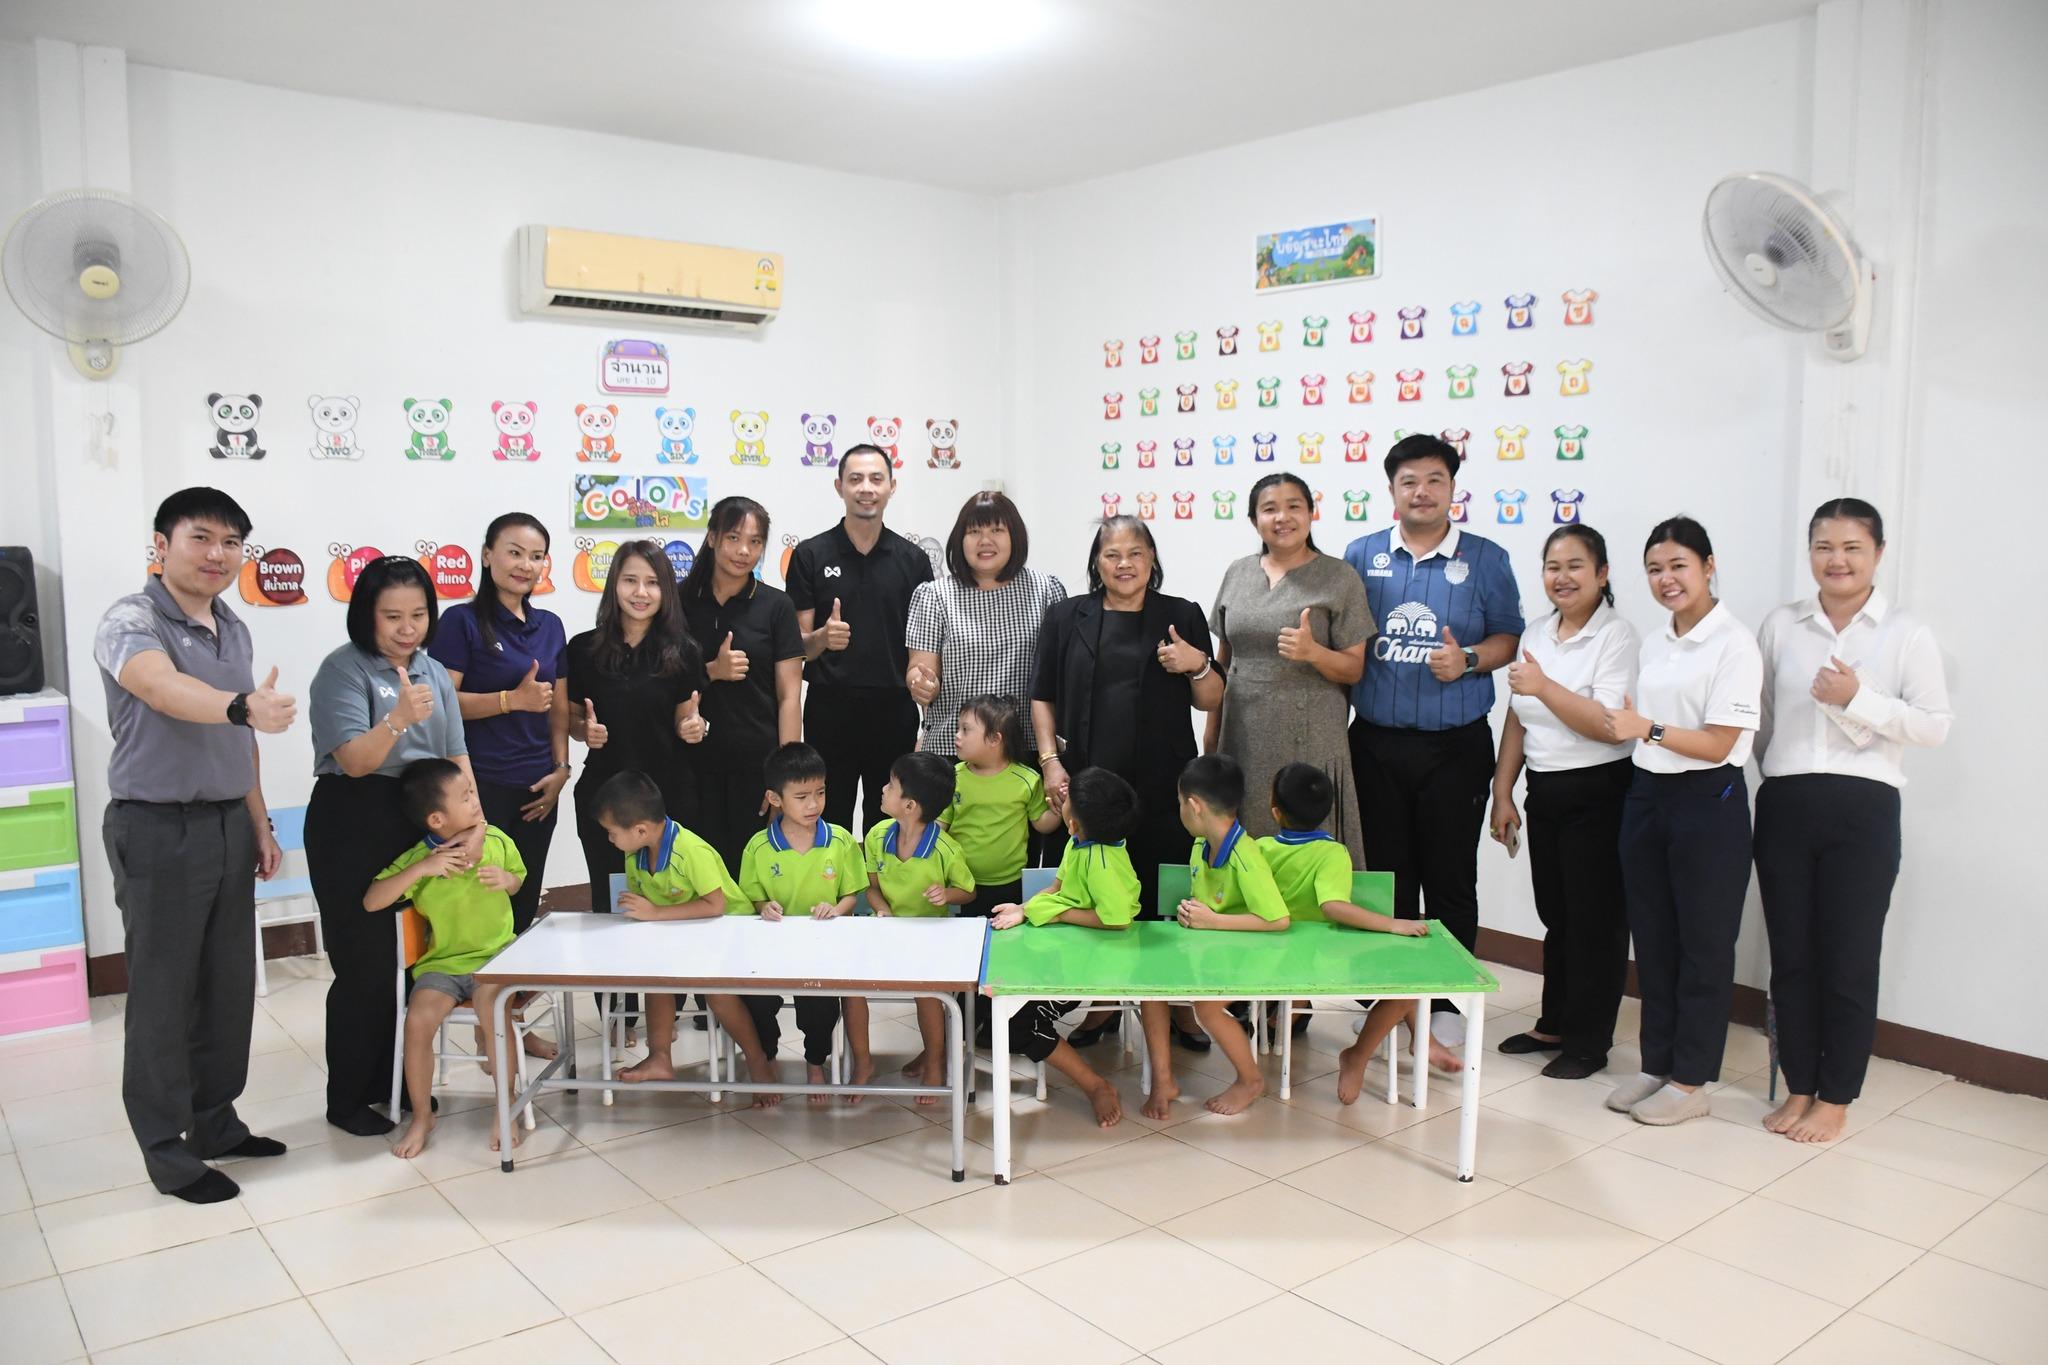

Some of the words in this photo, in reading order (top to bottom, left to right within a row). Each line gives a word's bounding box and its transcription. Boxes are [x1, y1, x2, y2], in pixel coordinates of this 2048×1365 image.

[611, 357, 662, 374] จำนวน
[647, 377, 657, 386] 10
[234, 434, 241, 446] 1
[326, 447, 350, 456] TWO
[505, 448, 528, 457] FOUR
[589, 450, 610, 460] FIVE
[670, 452, 686, 461] SIX
[586, 478, 701, 518] Colors
[260, 561, 302, 574] Brown
[437, 555, 466, 569] Red
[263, 576, 299, 591] สีน้ำตาล
[437, 572, 466, 584] สีแดง
[1375, 637, 1433, 664] Chan
